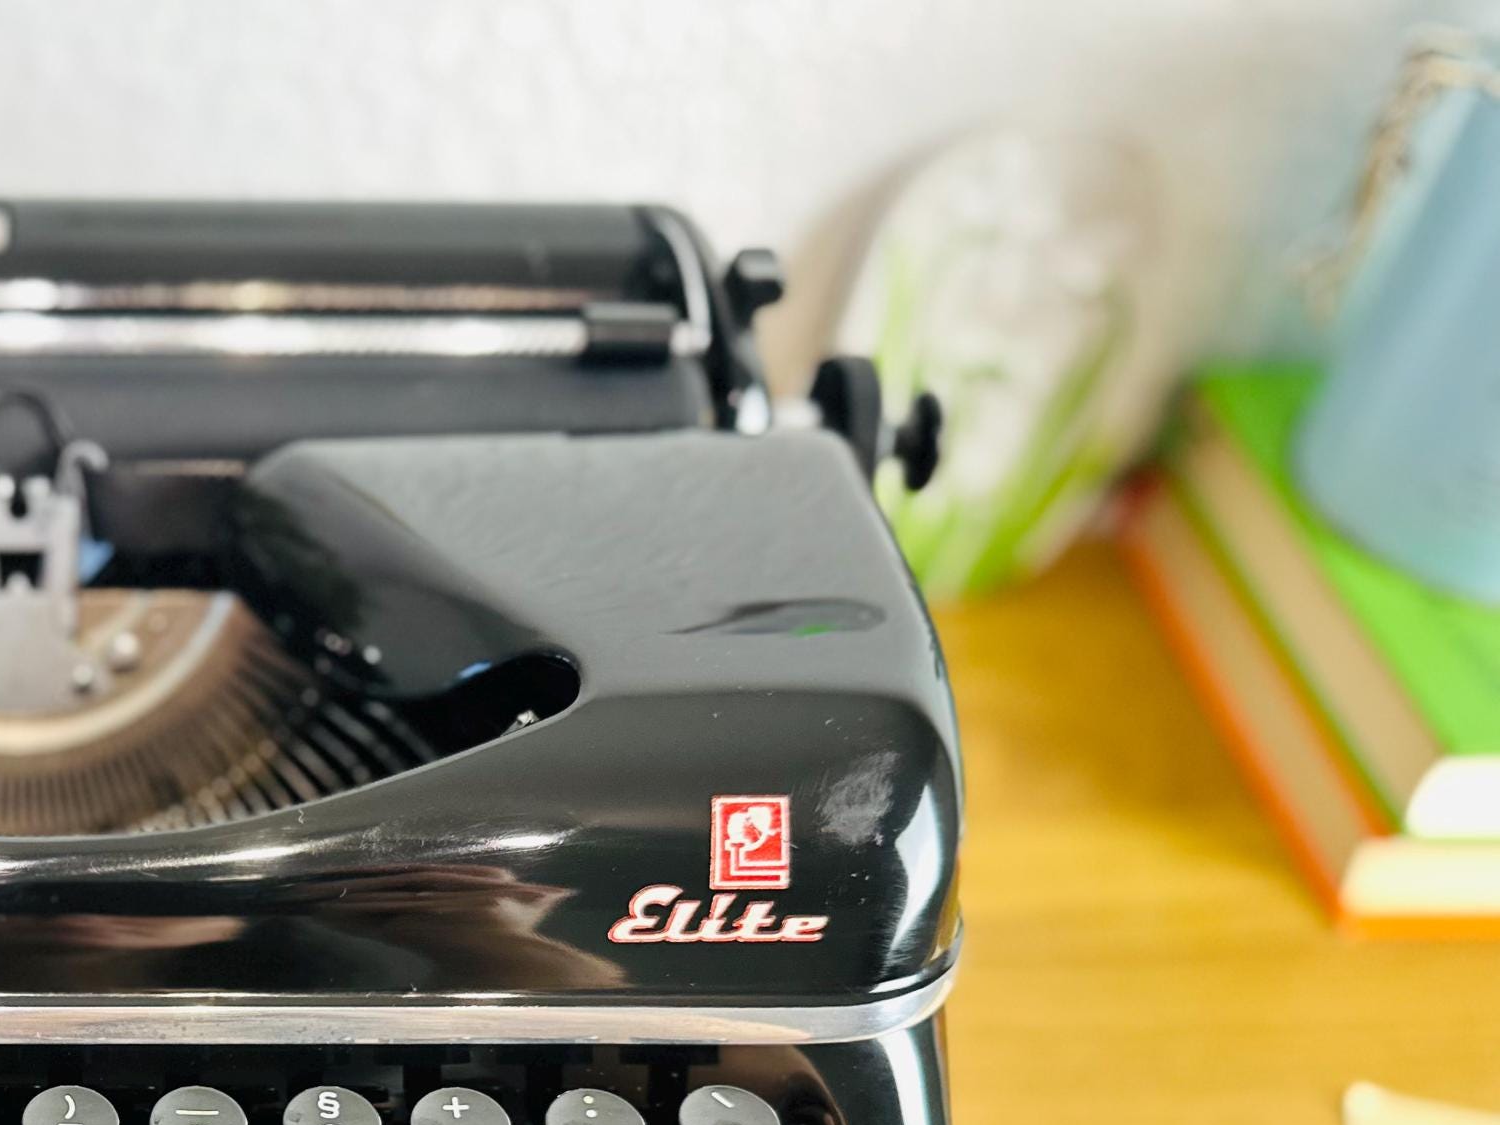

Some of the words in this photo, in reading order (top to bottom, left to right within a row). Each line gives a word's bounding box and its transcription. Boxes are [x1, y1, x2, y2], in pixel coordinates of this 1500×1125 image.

[607, 884, 829, 943] Elite
[64, 1094, 76, 1120] )
[317, 1091, 340, 1119] §
[442, 1096, 470, 1119] +
